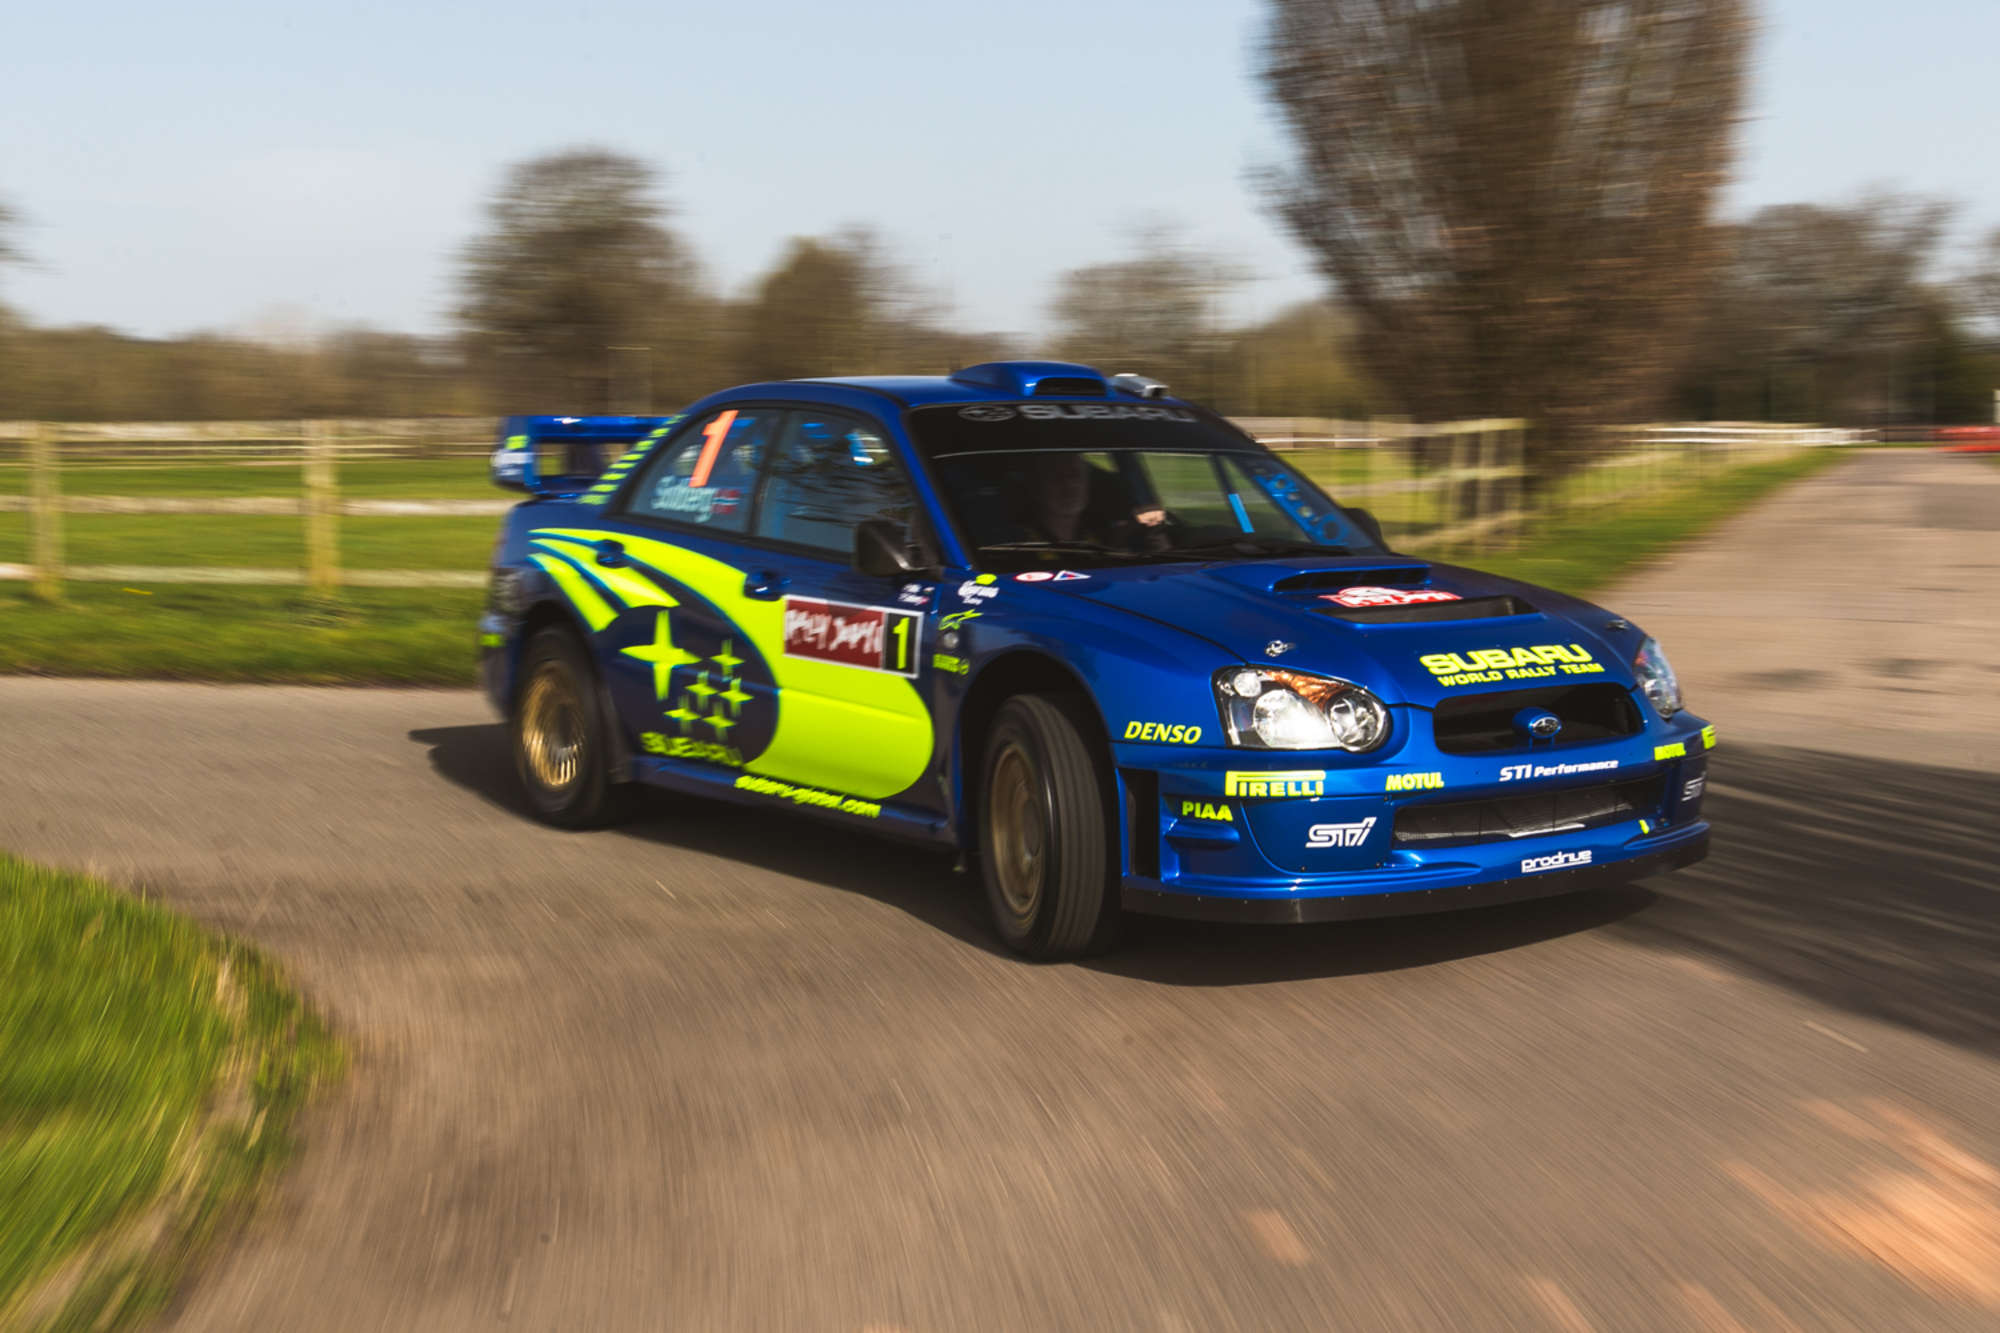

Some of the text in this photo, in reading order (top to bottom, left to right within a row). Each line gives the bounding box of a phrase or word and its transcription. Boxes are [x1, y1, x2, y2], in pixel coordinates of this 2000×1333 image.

[1018, 405, 1197, 423] SUBARU
[688, 409, 739, 488] 1
[893, 617, 910, 670] 1
[1419, 644, 1593, 675] SUBARU
[1437, 662, 1605, 687] WORLD RALLY TEAM
[1124, 721, 1202, 744] DENSO
[1534, 760, 1619, 777] Performance
[1225, 770, 1326, 797] PIRELLI
[1385, 772, 1445, 791] MOTUL
[1182, 801, 1233, 821] PIAA
[1521, 850, 1592, 873] prodrive
